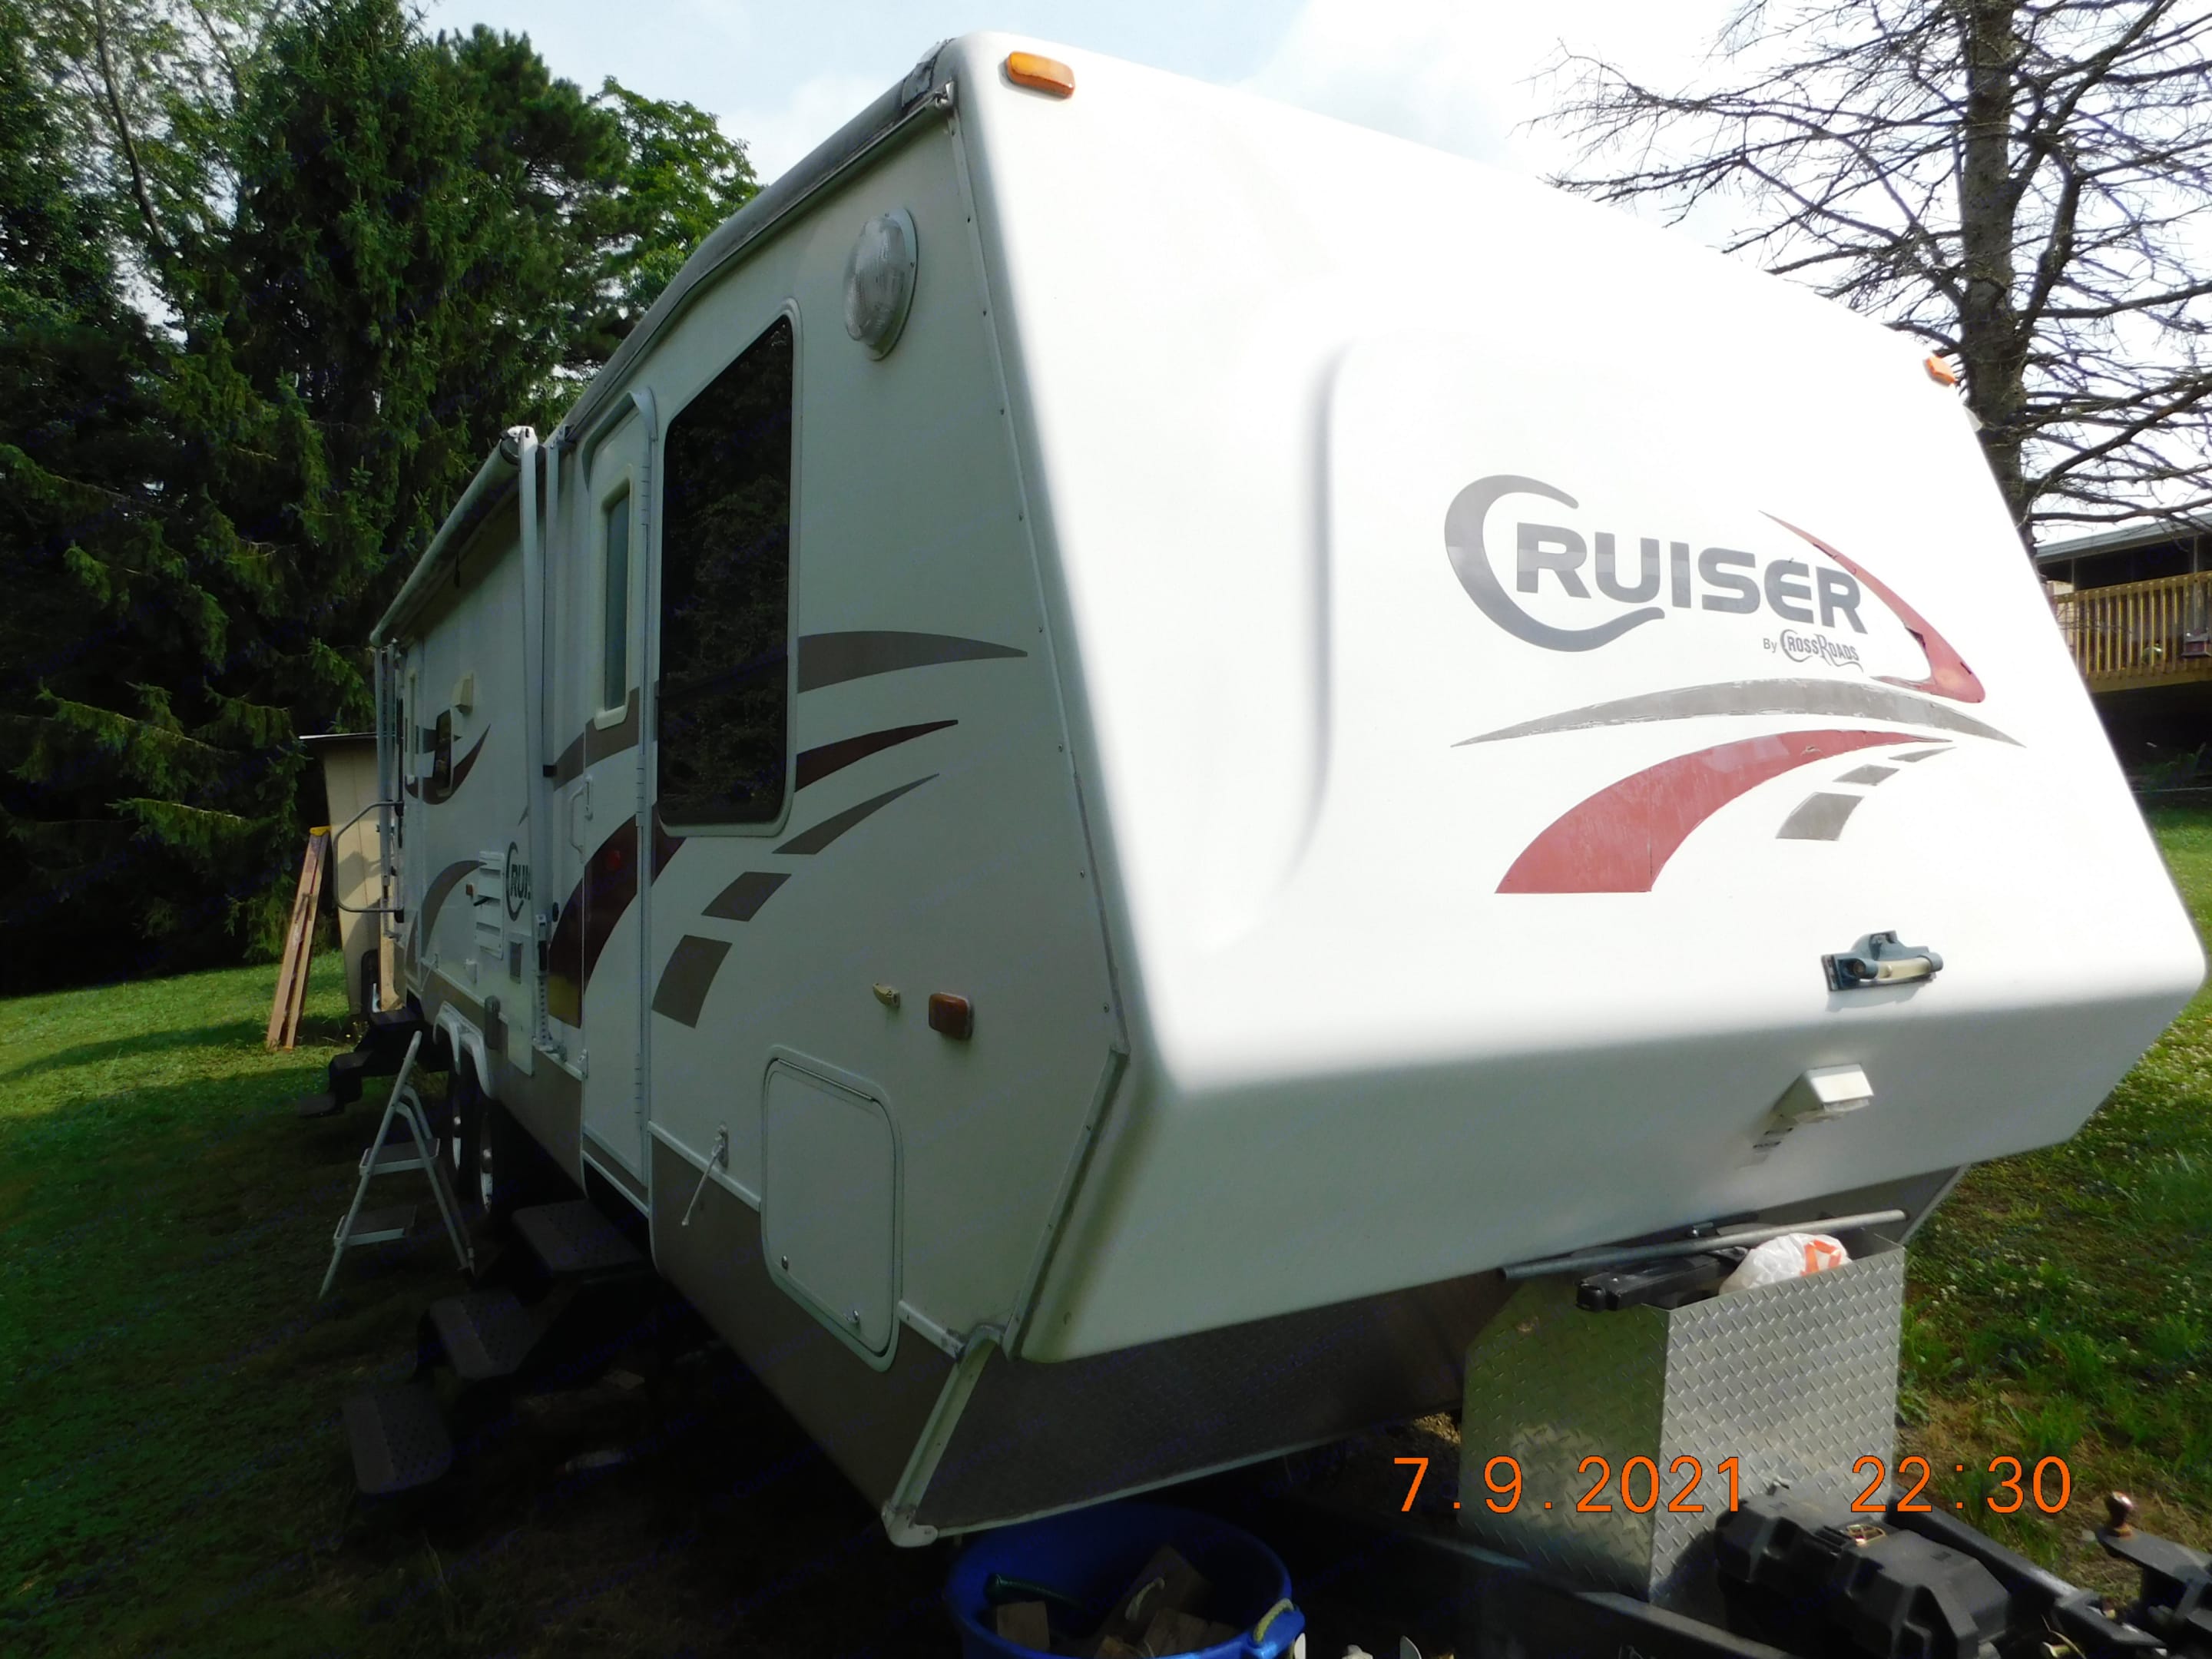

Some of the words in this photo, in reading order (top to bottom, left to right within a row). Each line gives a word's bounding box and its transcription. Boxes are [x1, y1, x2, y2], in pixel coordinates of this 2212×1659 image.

[1445, 474, 1868, 652] CRUISER
[1763, 637, 1777, 654] By
[505, 841, 531, 922] CRUI
